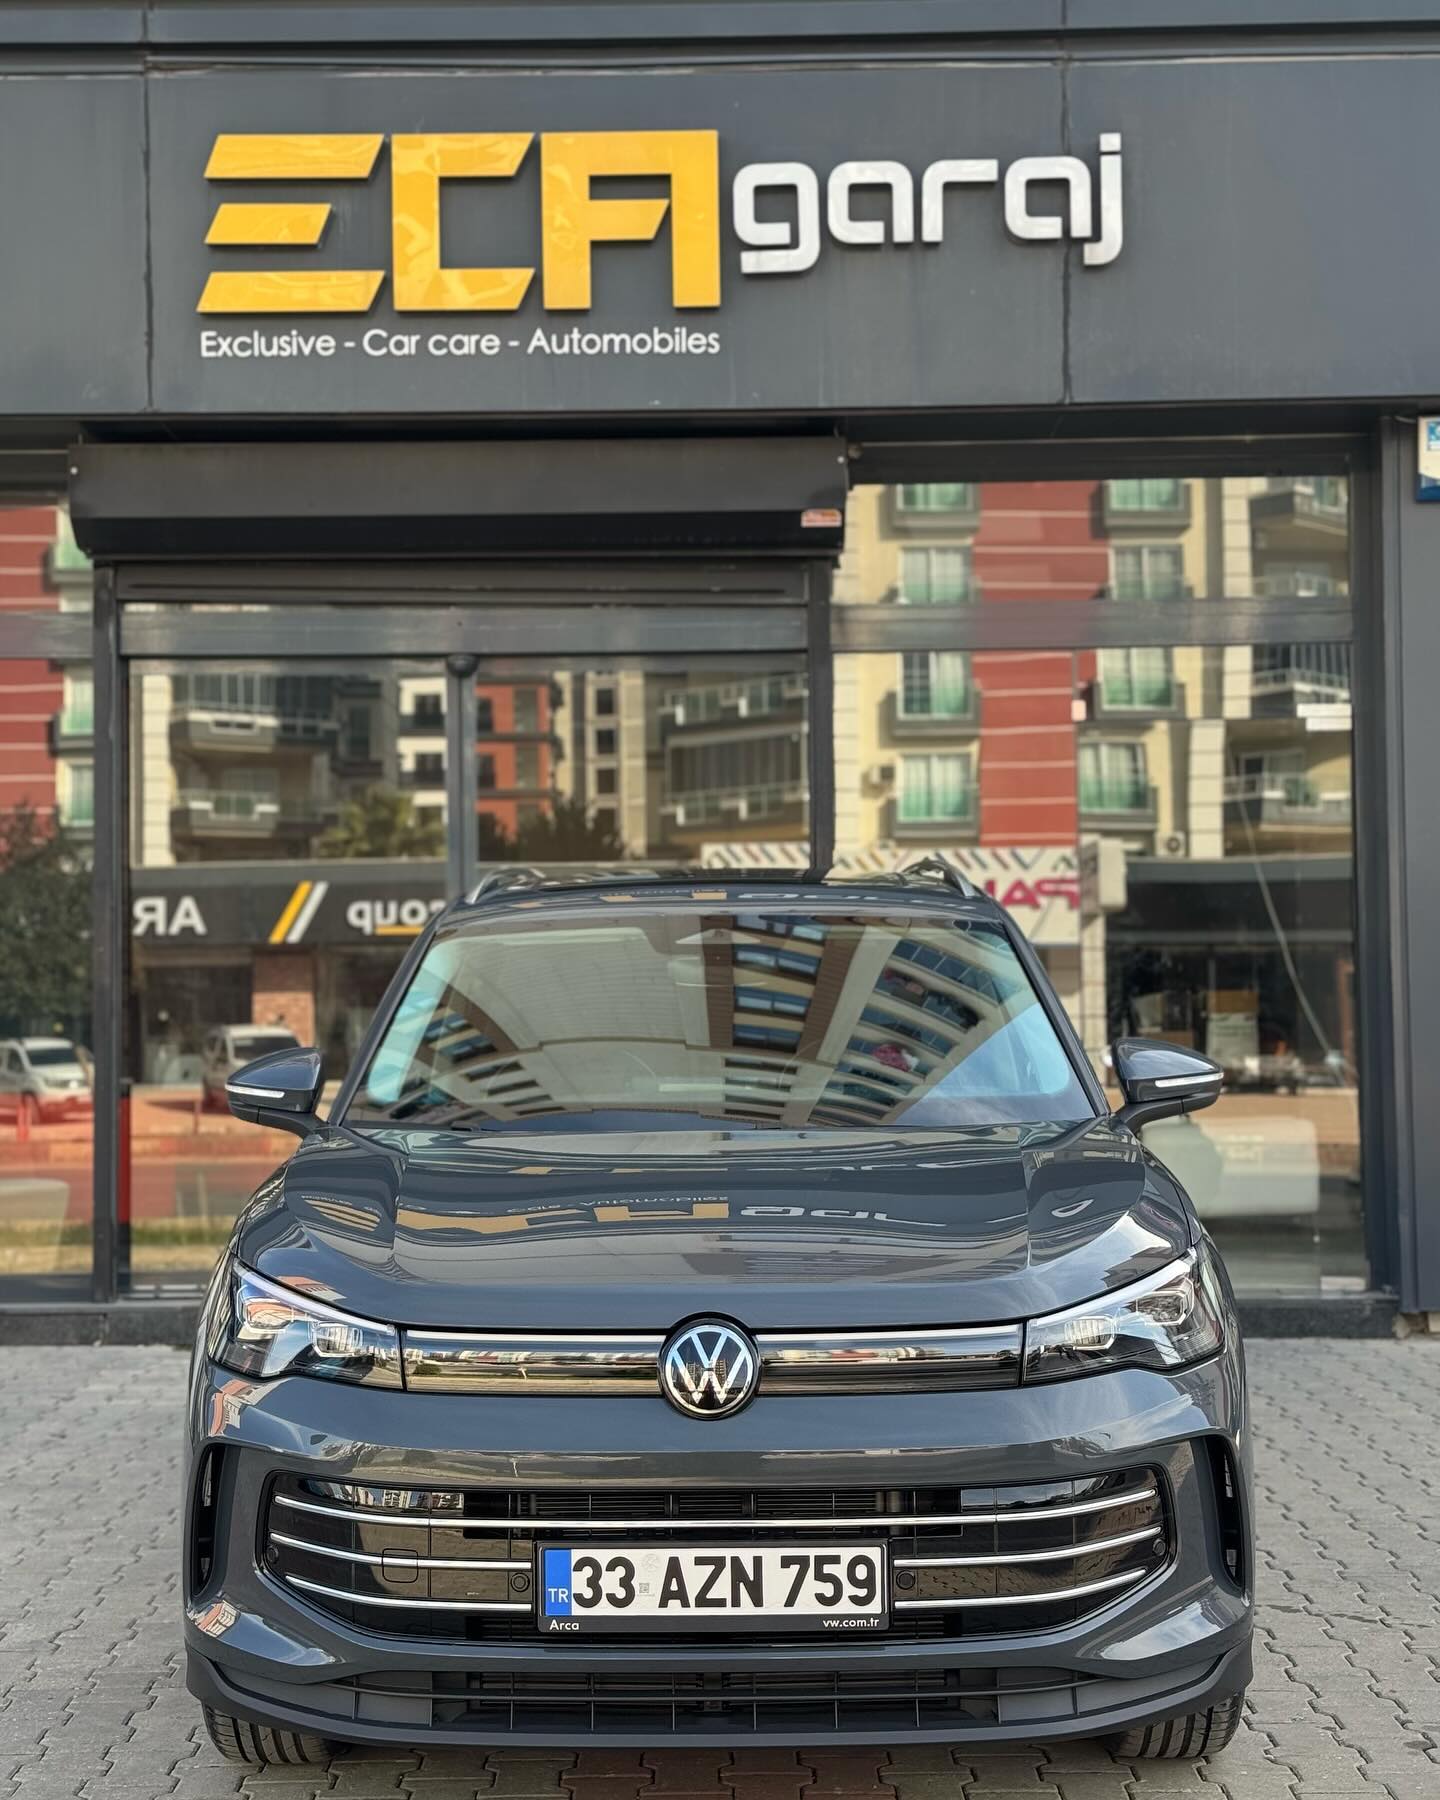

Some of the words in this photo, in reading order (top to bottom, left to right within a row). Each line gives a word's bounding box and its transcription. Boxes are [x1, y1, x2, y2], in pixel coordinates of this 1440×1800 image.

[196, 129, 722, 313] ECA
[732, 132, 1124, 274] garaj
[199, 329, 337, 358] Exclusive
[362, 328, 421, 357] Car
[427, 333, 502, 356] care
[526, 326, 722, 355] Automobiles
[547, 1588, 569, 1603] TR
[572, 1556, 636, 1609] 33
[658, 1555, 764, 1609] AZN
[780, 1554, 877, 1608] 759
[549, 1619, 580, 1631] Arca
[822, 1617, 880, 1628] vw.com.tr
